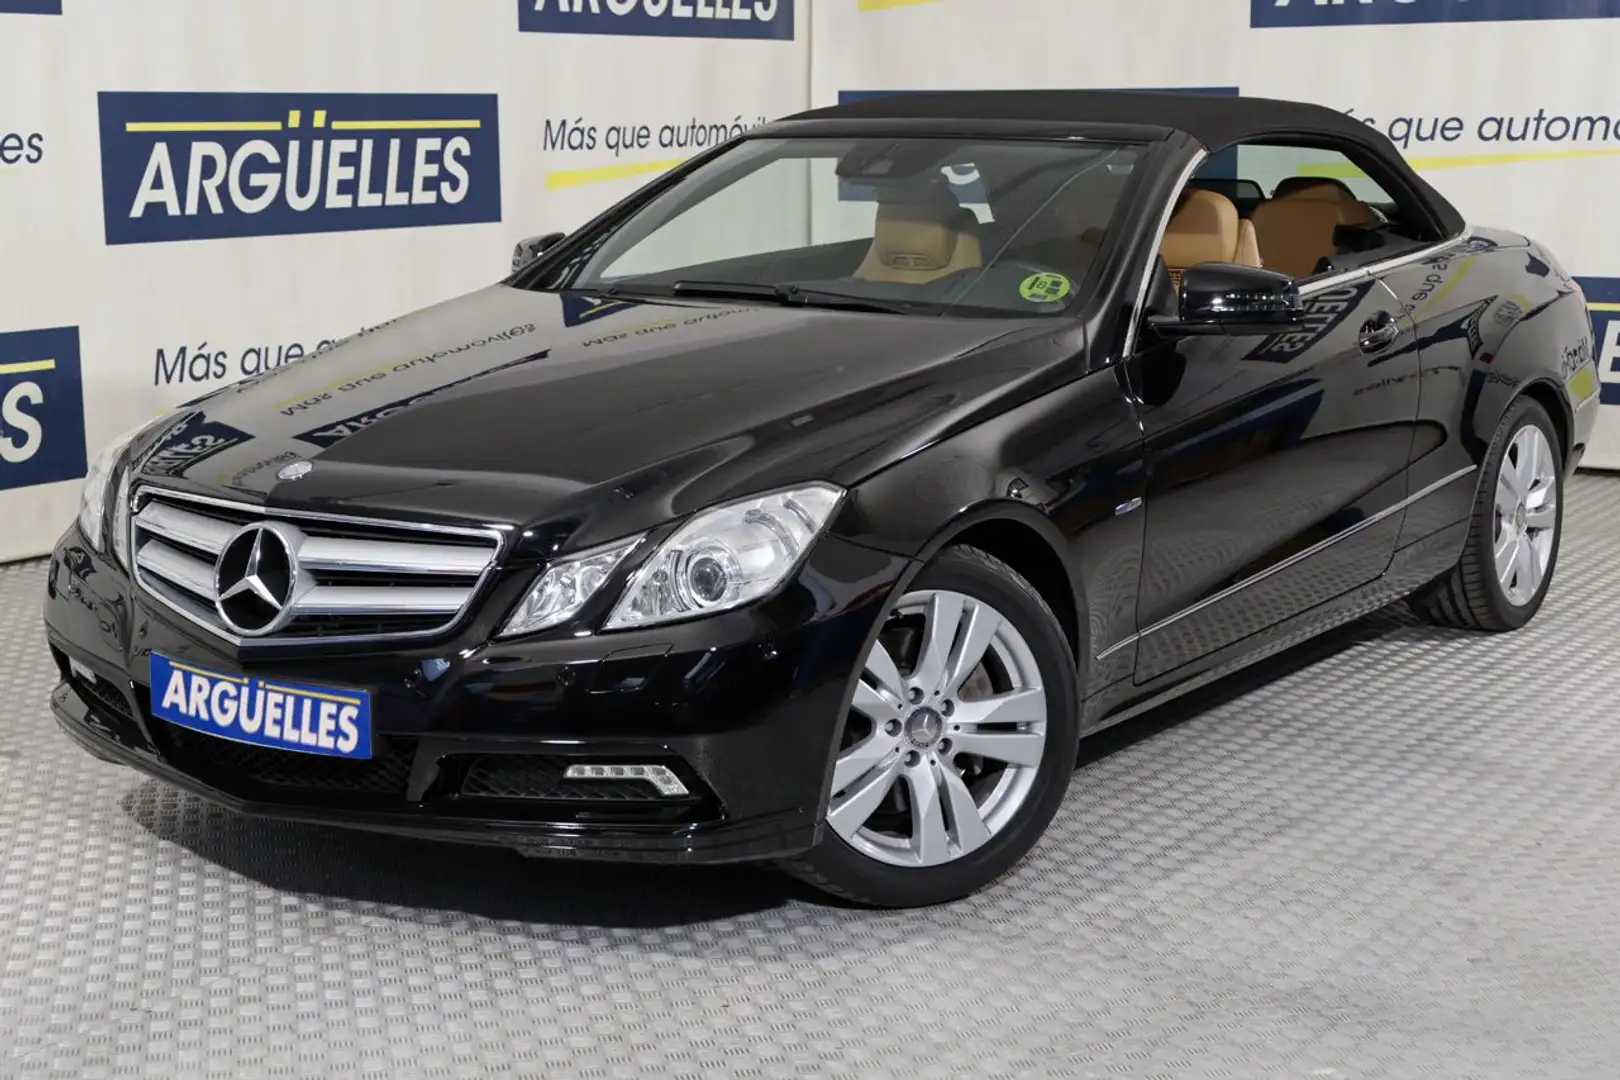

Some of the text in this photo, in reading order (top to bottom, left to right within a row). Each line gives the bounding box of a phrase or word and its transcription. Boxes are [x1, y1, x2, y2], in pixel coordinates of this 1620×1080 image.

[543, 117, 597, 151] Más
[605, 124, 650, 156] que
[1388, 116, 1463, 149] que
[129, 110, 472, 218] ARGÜELLES
[154, 342, 227, 386] Más
[161, 669, 360, 754] ARGÜELLES
